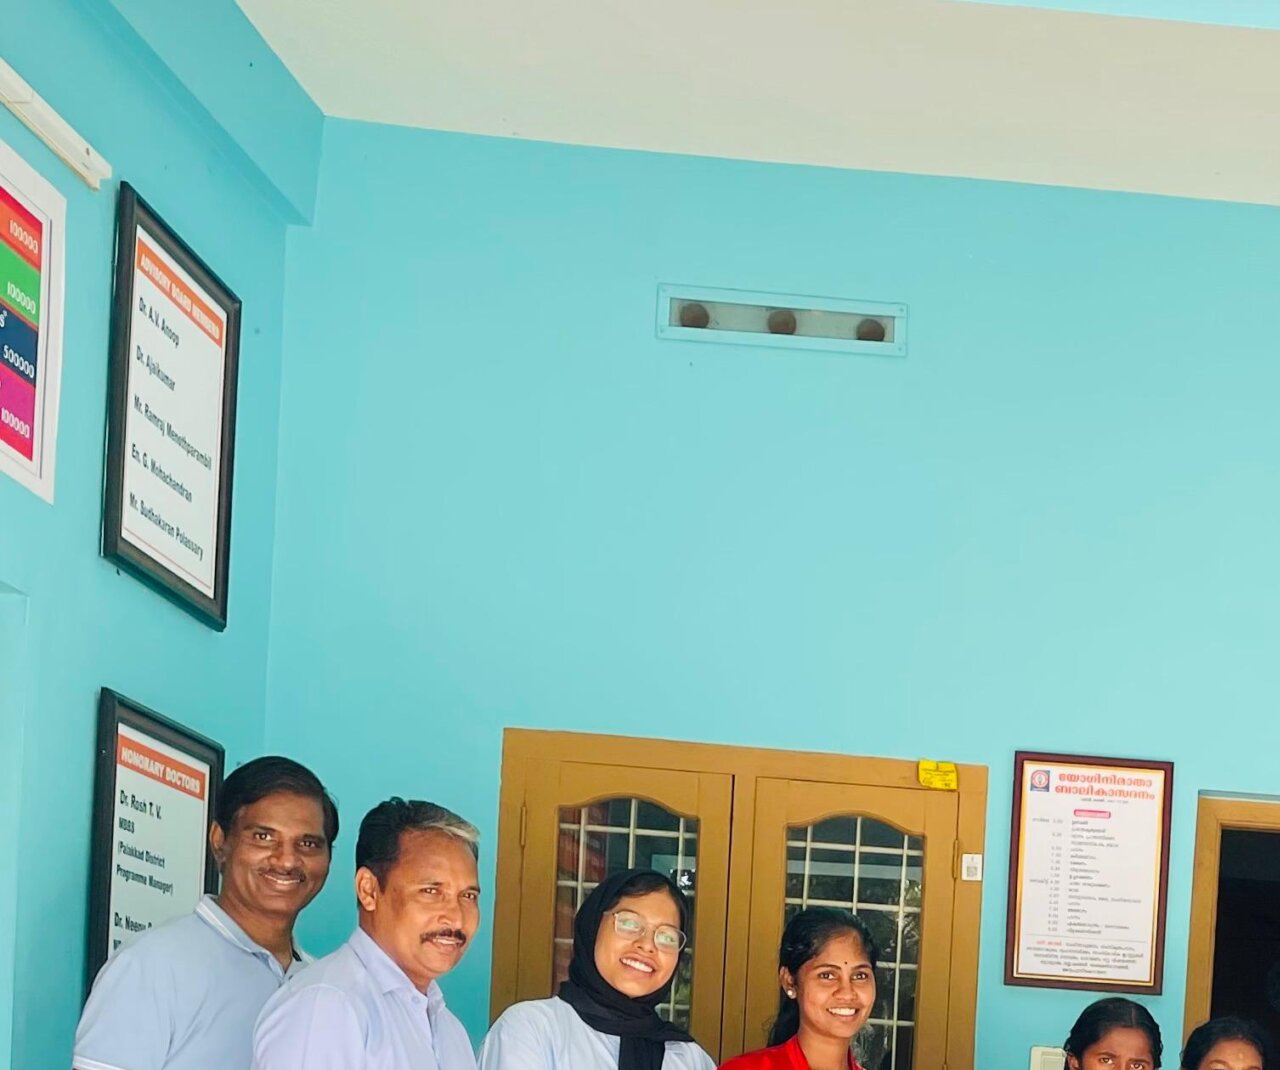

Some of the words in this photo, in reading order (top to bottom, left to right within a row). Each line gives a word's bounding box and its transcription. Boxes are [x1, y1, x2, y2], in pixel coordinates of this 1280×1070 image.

[10, 219, 39, 254] 100000
[7, 281, 37, 315] 100000
[3, 345, 35, 379] 500000
[1, 408, 31, 439] 100000
[121, 746, 165, 778] HONORARY
[165, 766, 201, 794] DOCTORS
[120, 789, 129, 807] Dr.
